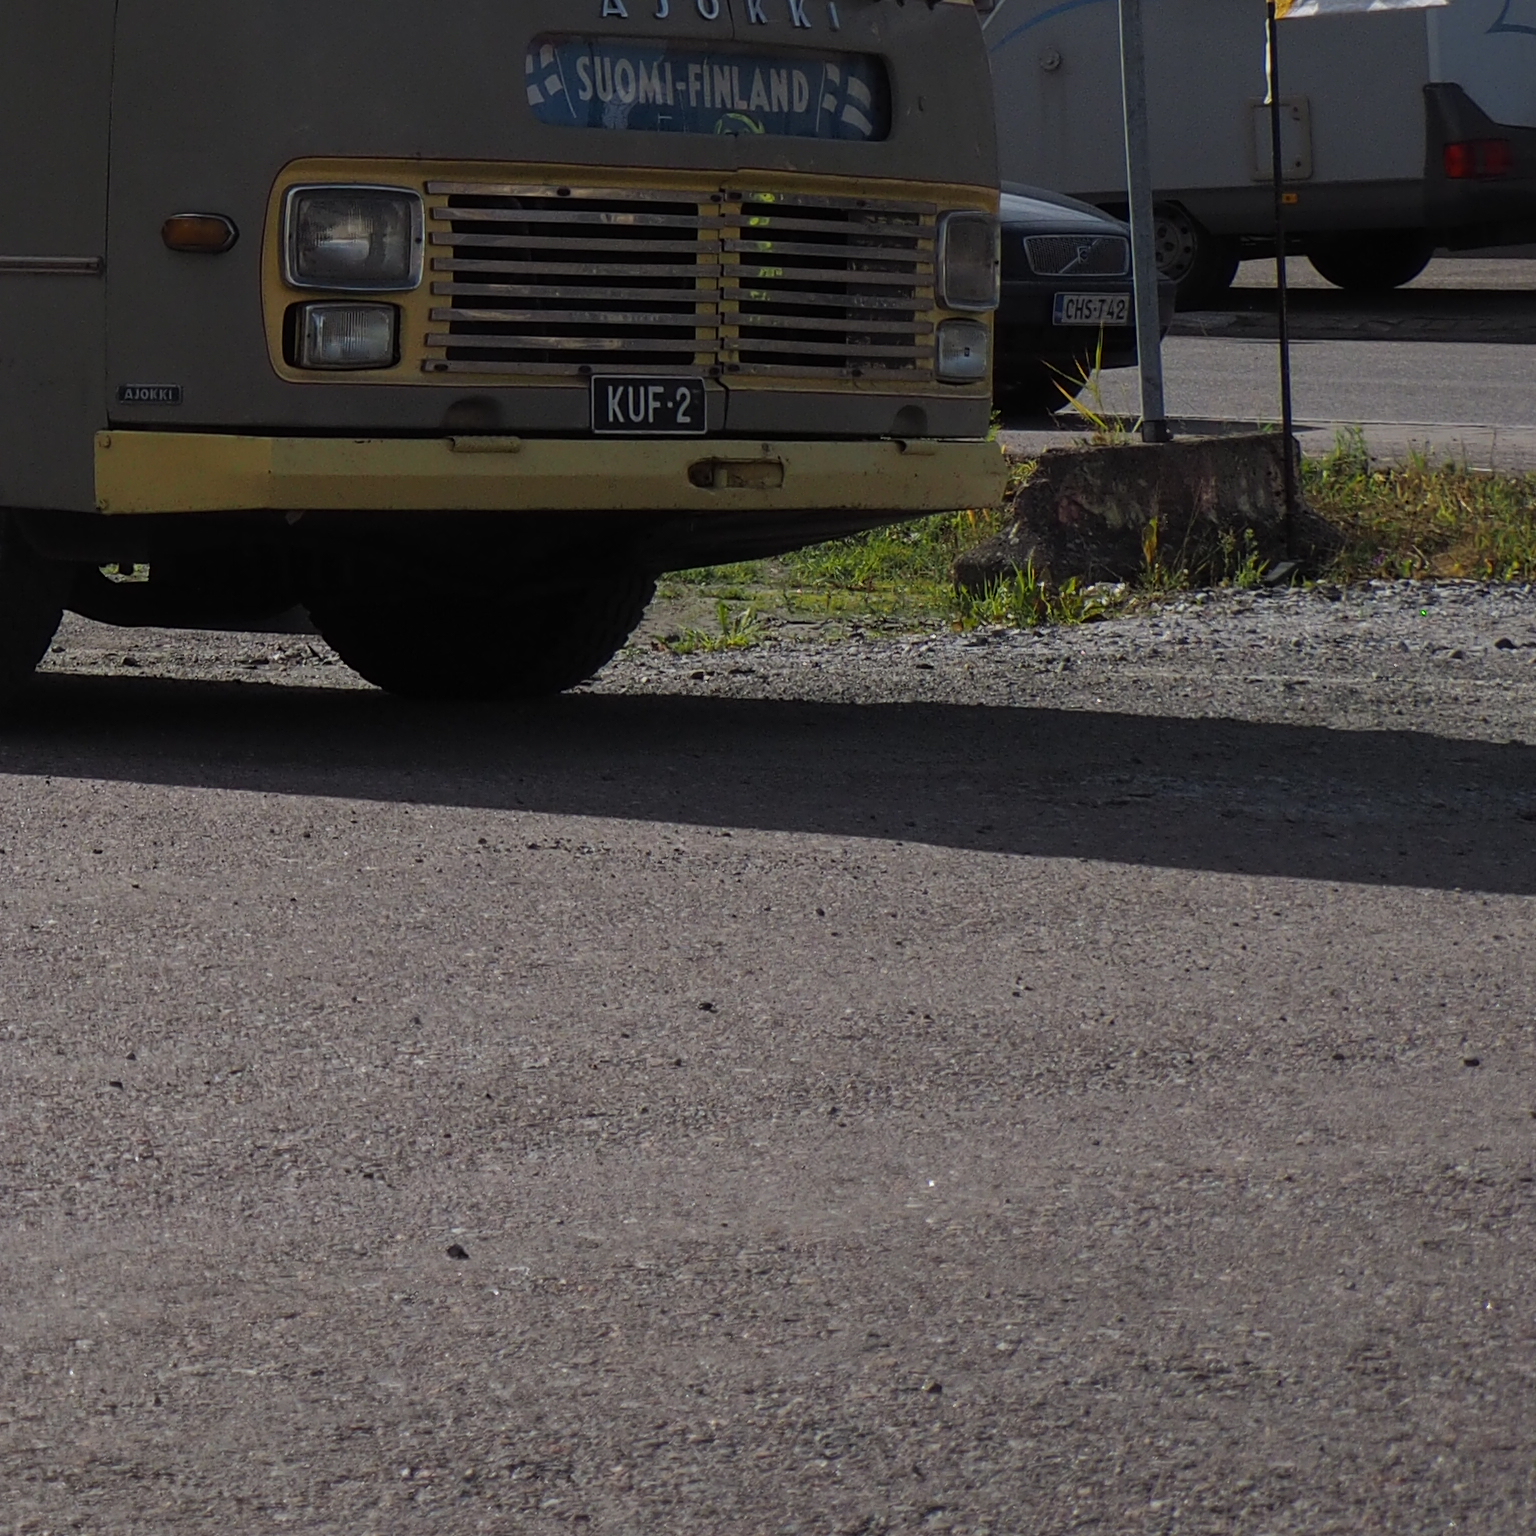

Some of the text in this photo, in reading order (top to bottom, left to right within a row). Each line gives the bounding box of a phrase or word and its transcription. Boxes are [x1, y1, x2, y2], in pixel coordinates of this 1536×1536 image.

[575, 55, 811, 114] SUOMI-FINLAND
[1065, 298, 1126, 321] CHS-742
[124, 387, 173, 401] AJOKKI
[607, 385, 692, 424] KUF-2
